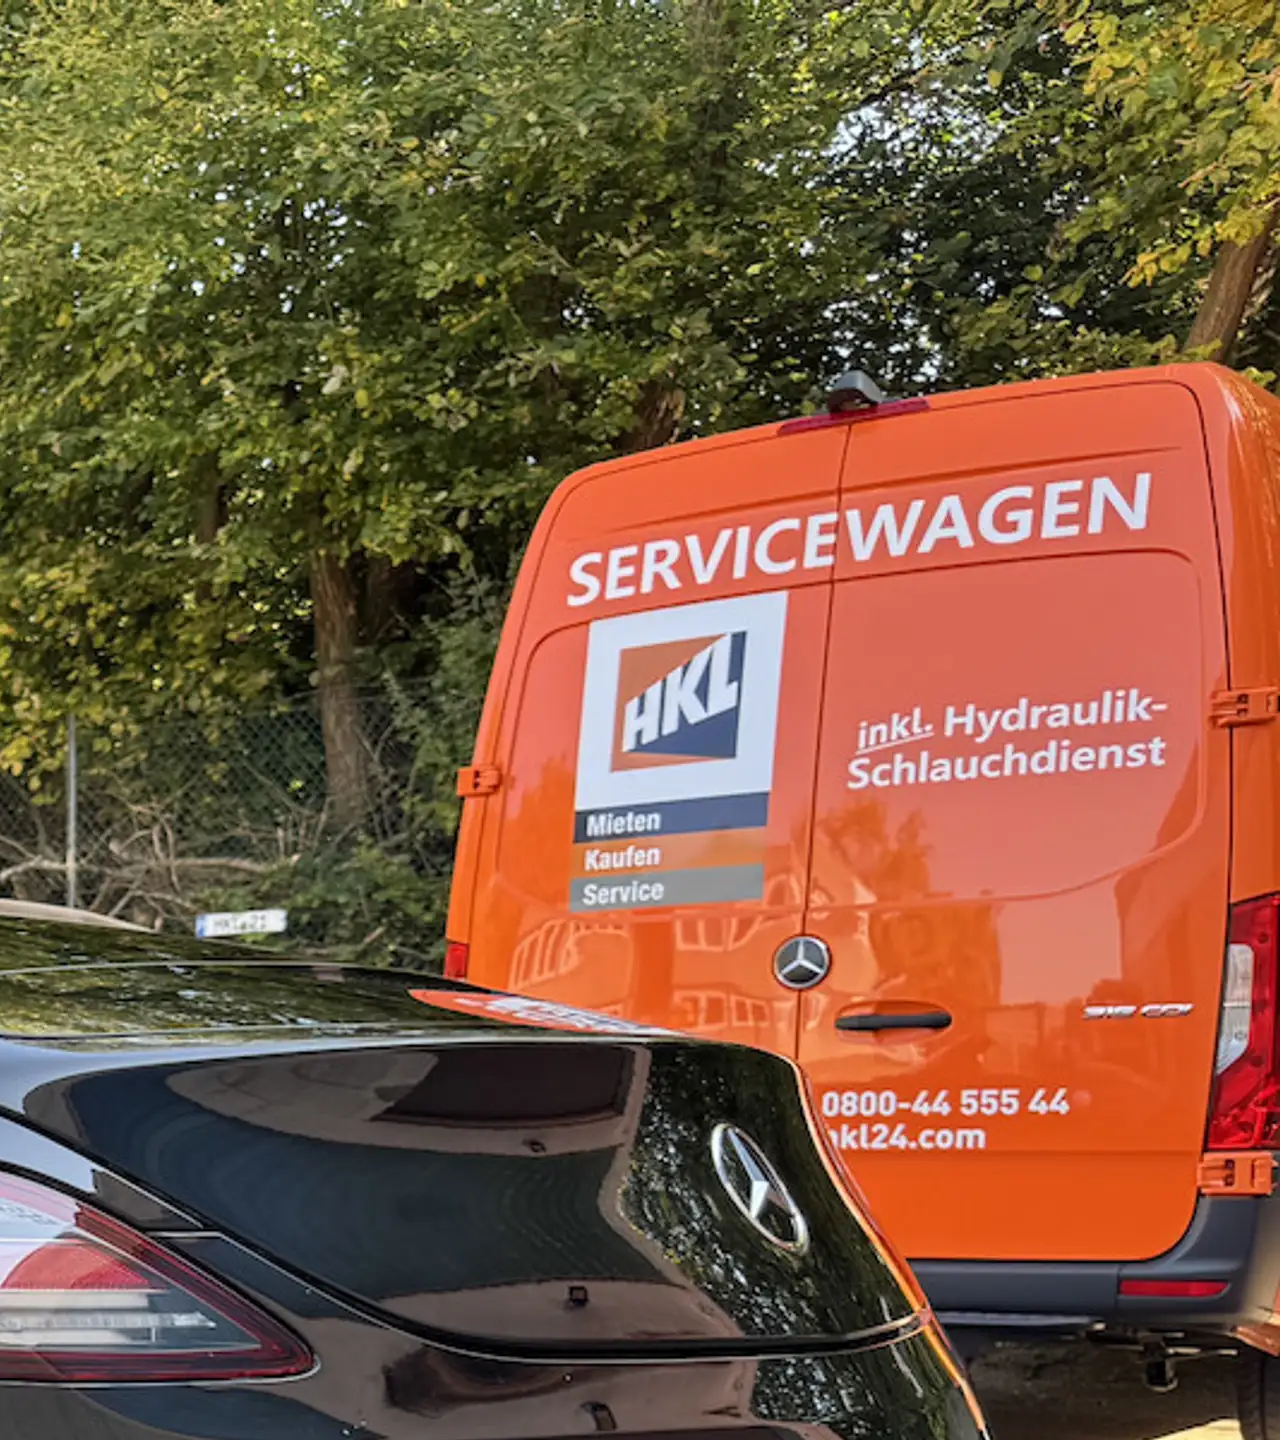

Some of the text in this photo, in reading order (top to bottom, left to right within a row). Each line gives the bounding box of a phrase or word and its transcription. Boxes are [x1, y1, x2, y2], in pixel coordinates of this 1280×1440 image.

[566, 472, 1152, 606] SERVICEWAGEN
[621, 633, 739, 753] HKL
[857, 688, 1168, 750] inkl. Hydraulik-
[846, 738, 1167, 790] Schlauchdienst
[585, 806, 661, 837] Mieten
[583, 844, 661, 871] Kaufen
[581, 878, 665, 906] Service
[822, 1087, 1071, 1117] 0800-44 555 44
